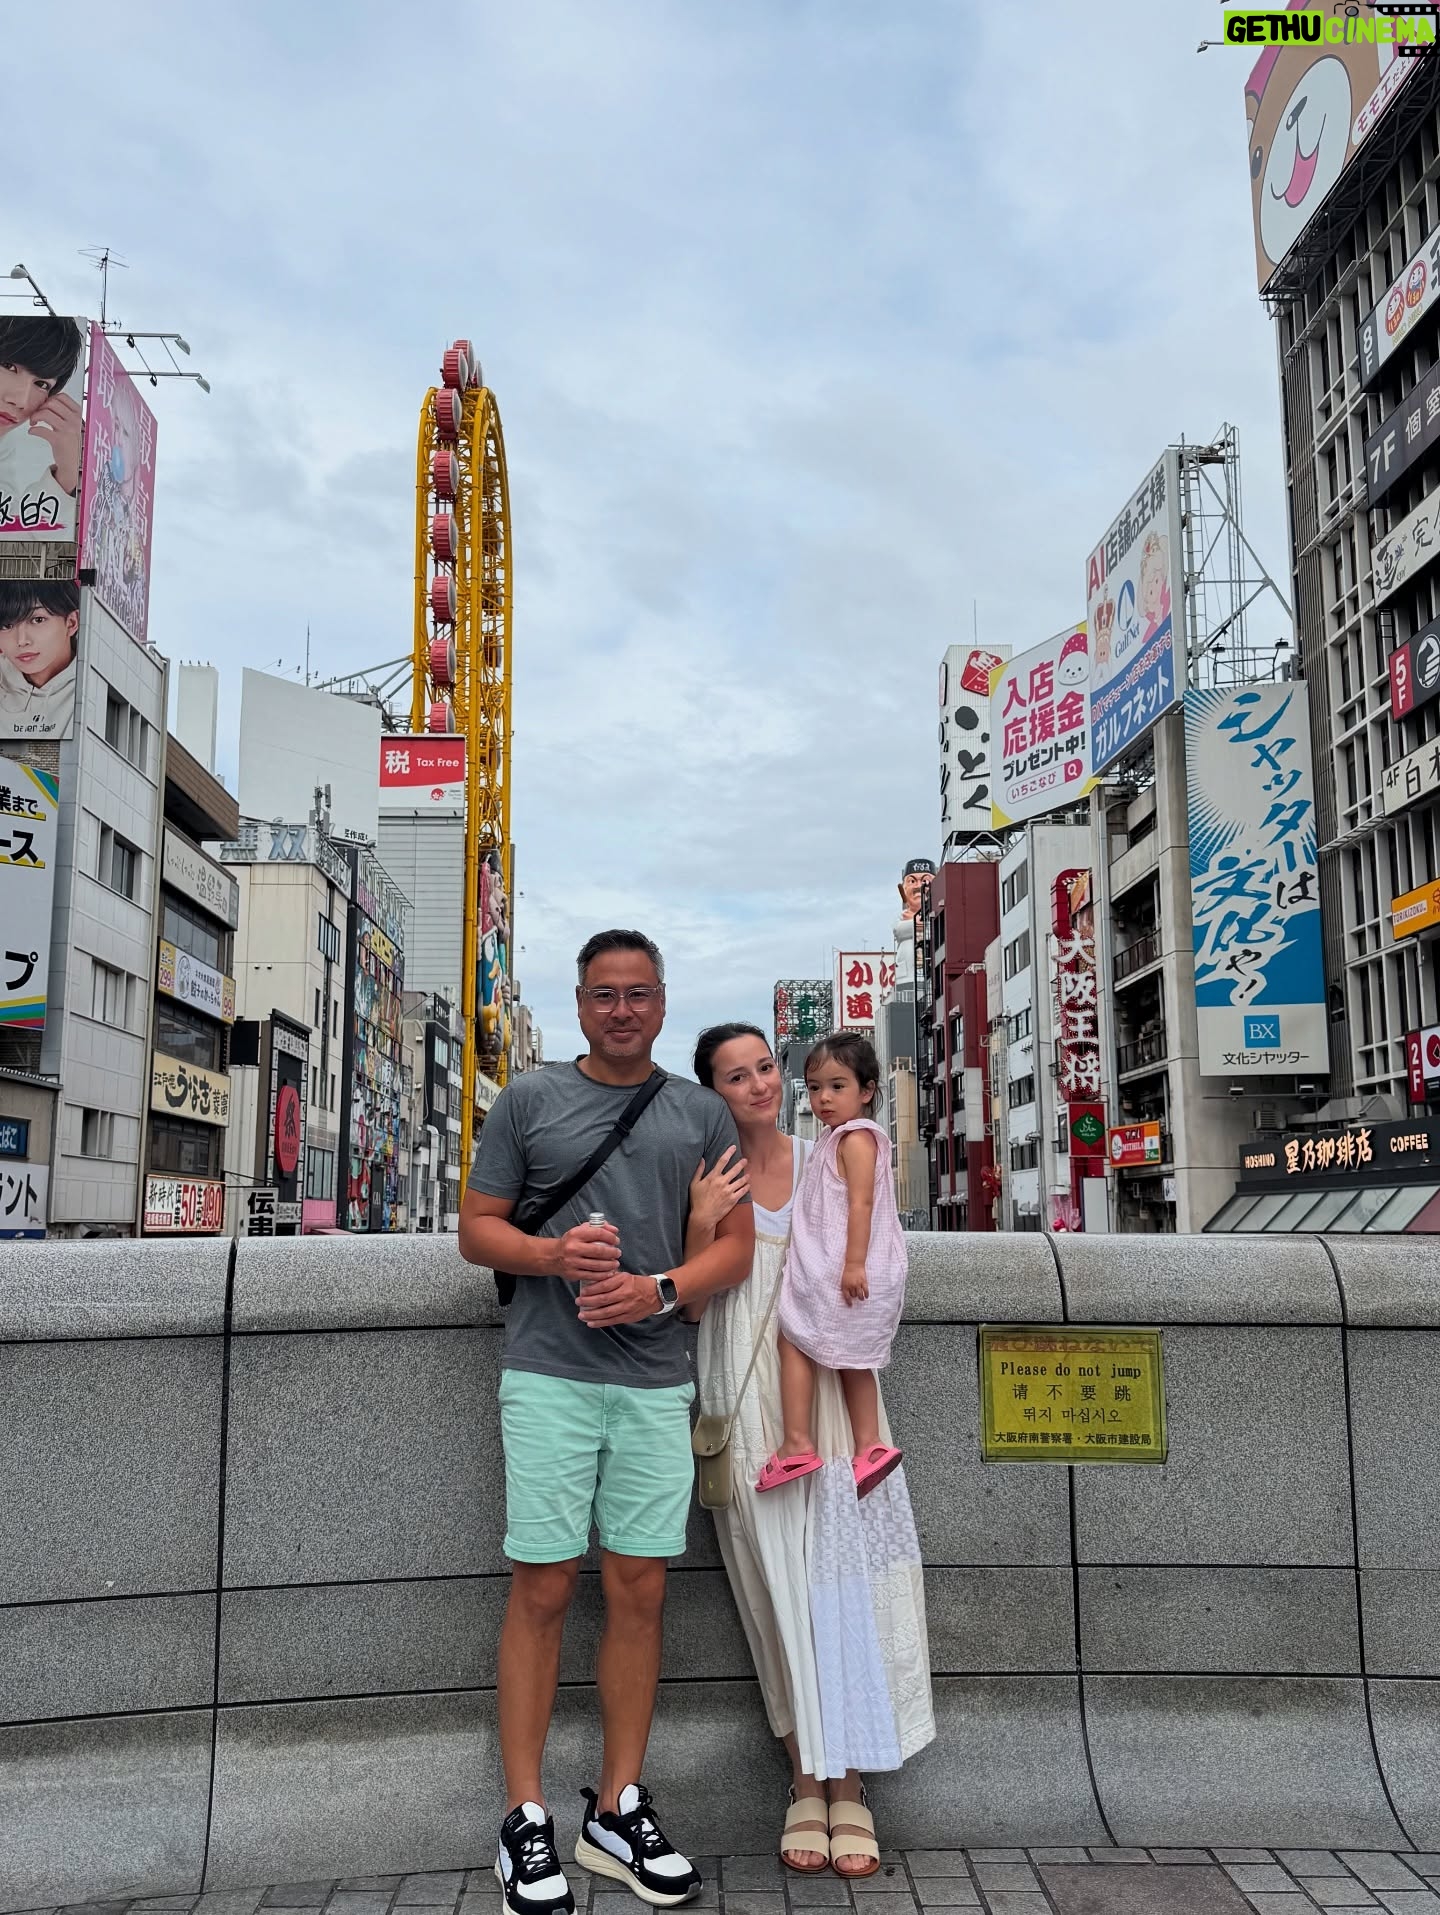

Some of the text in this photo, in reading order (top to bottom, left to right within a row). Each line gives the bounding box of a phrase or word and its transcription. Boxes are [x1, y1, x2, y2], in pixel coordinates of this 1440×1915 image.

[1363, 325, 1373, 376] 8F
[1370, 385, 1440, 484] 7F 個室
[1115, 622, 1140, 658] GulfNet
[1003, 660, 1054, 718] 入店
[1395, 653, 1407, 709] 5F
[1003, 691, 1085, 759] 応援金
[1096, 664, 1169, 763] ガルフネット
[385, 750, 410, 774] 税
[416, 758, 460, 768] Tax Free
[1003, 731, 1086, 782] プレゼント中!
[1386, 766, 1399, 788] 4F
[1011, 771, 1057, 800] いちごなび
[5, 952, 39, 991] プ
[1052, 930, 1100, 1092] 大阪王将
[1249, 1023, 1276, 1039] BX
[165, 1065, 212, 1116] うなぎ
[1411, 1043, 1421, 1092] 2F
[1244, 1127, 1429, 1175] HOSHINO 星乃珈琲店 COFFEE
[202, 1186, 222, 1228] 190
[1001, 1361, 1142, 1380] Please do not jump
[1023, 1406, 1123, 1424] 뛰지 마십시오
